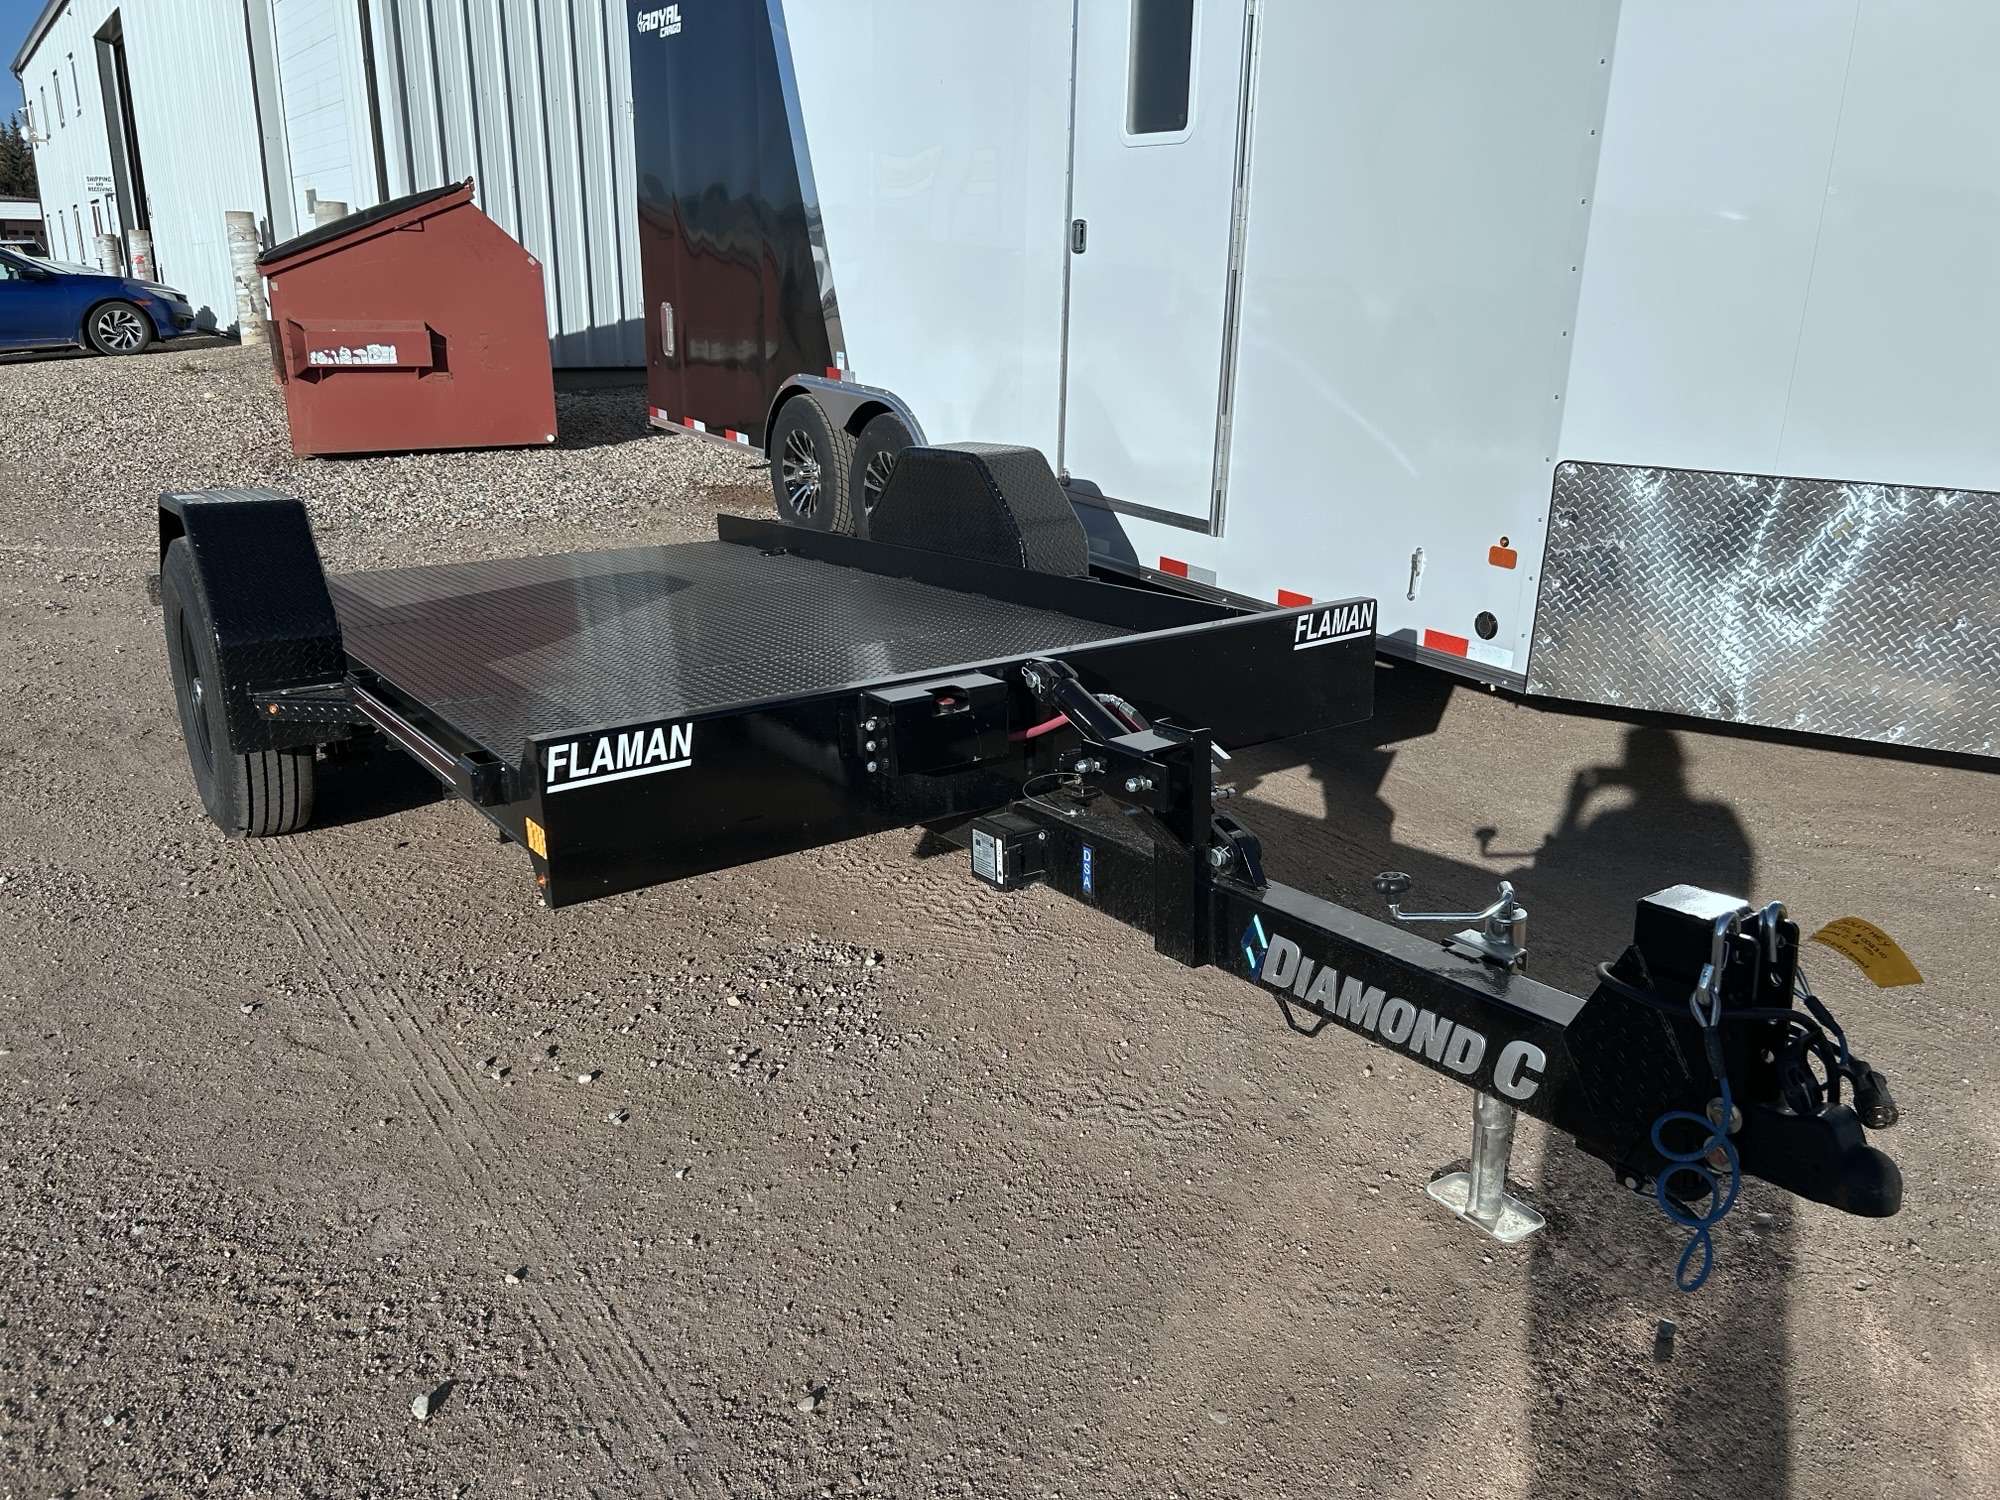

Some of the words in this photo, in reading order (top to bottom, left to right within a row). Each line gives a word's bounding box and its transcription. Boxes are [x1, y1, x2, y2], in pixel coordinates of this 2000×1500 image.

[642, 4, 681, 32] ROYAL
[1295, 601, 1375, 643] FLAMAN
[547, 722, 693, 783] FLAMAN
[1083, 848, 1092, 889] DSA
[1261, 932, 1487, 1075] DIAMOND
[1493, 1040, 1547, 1100] C
